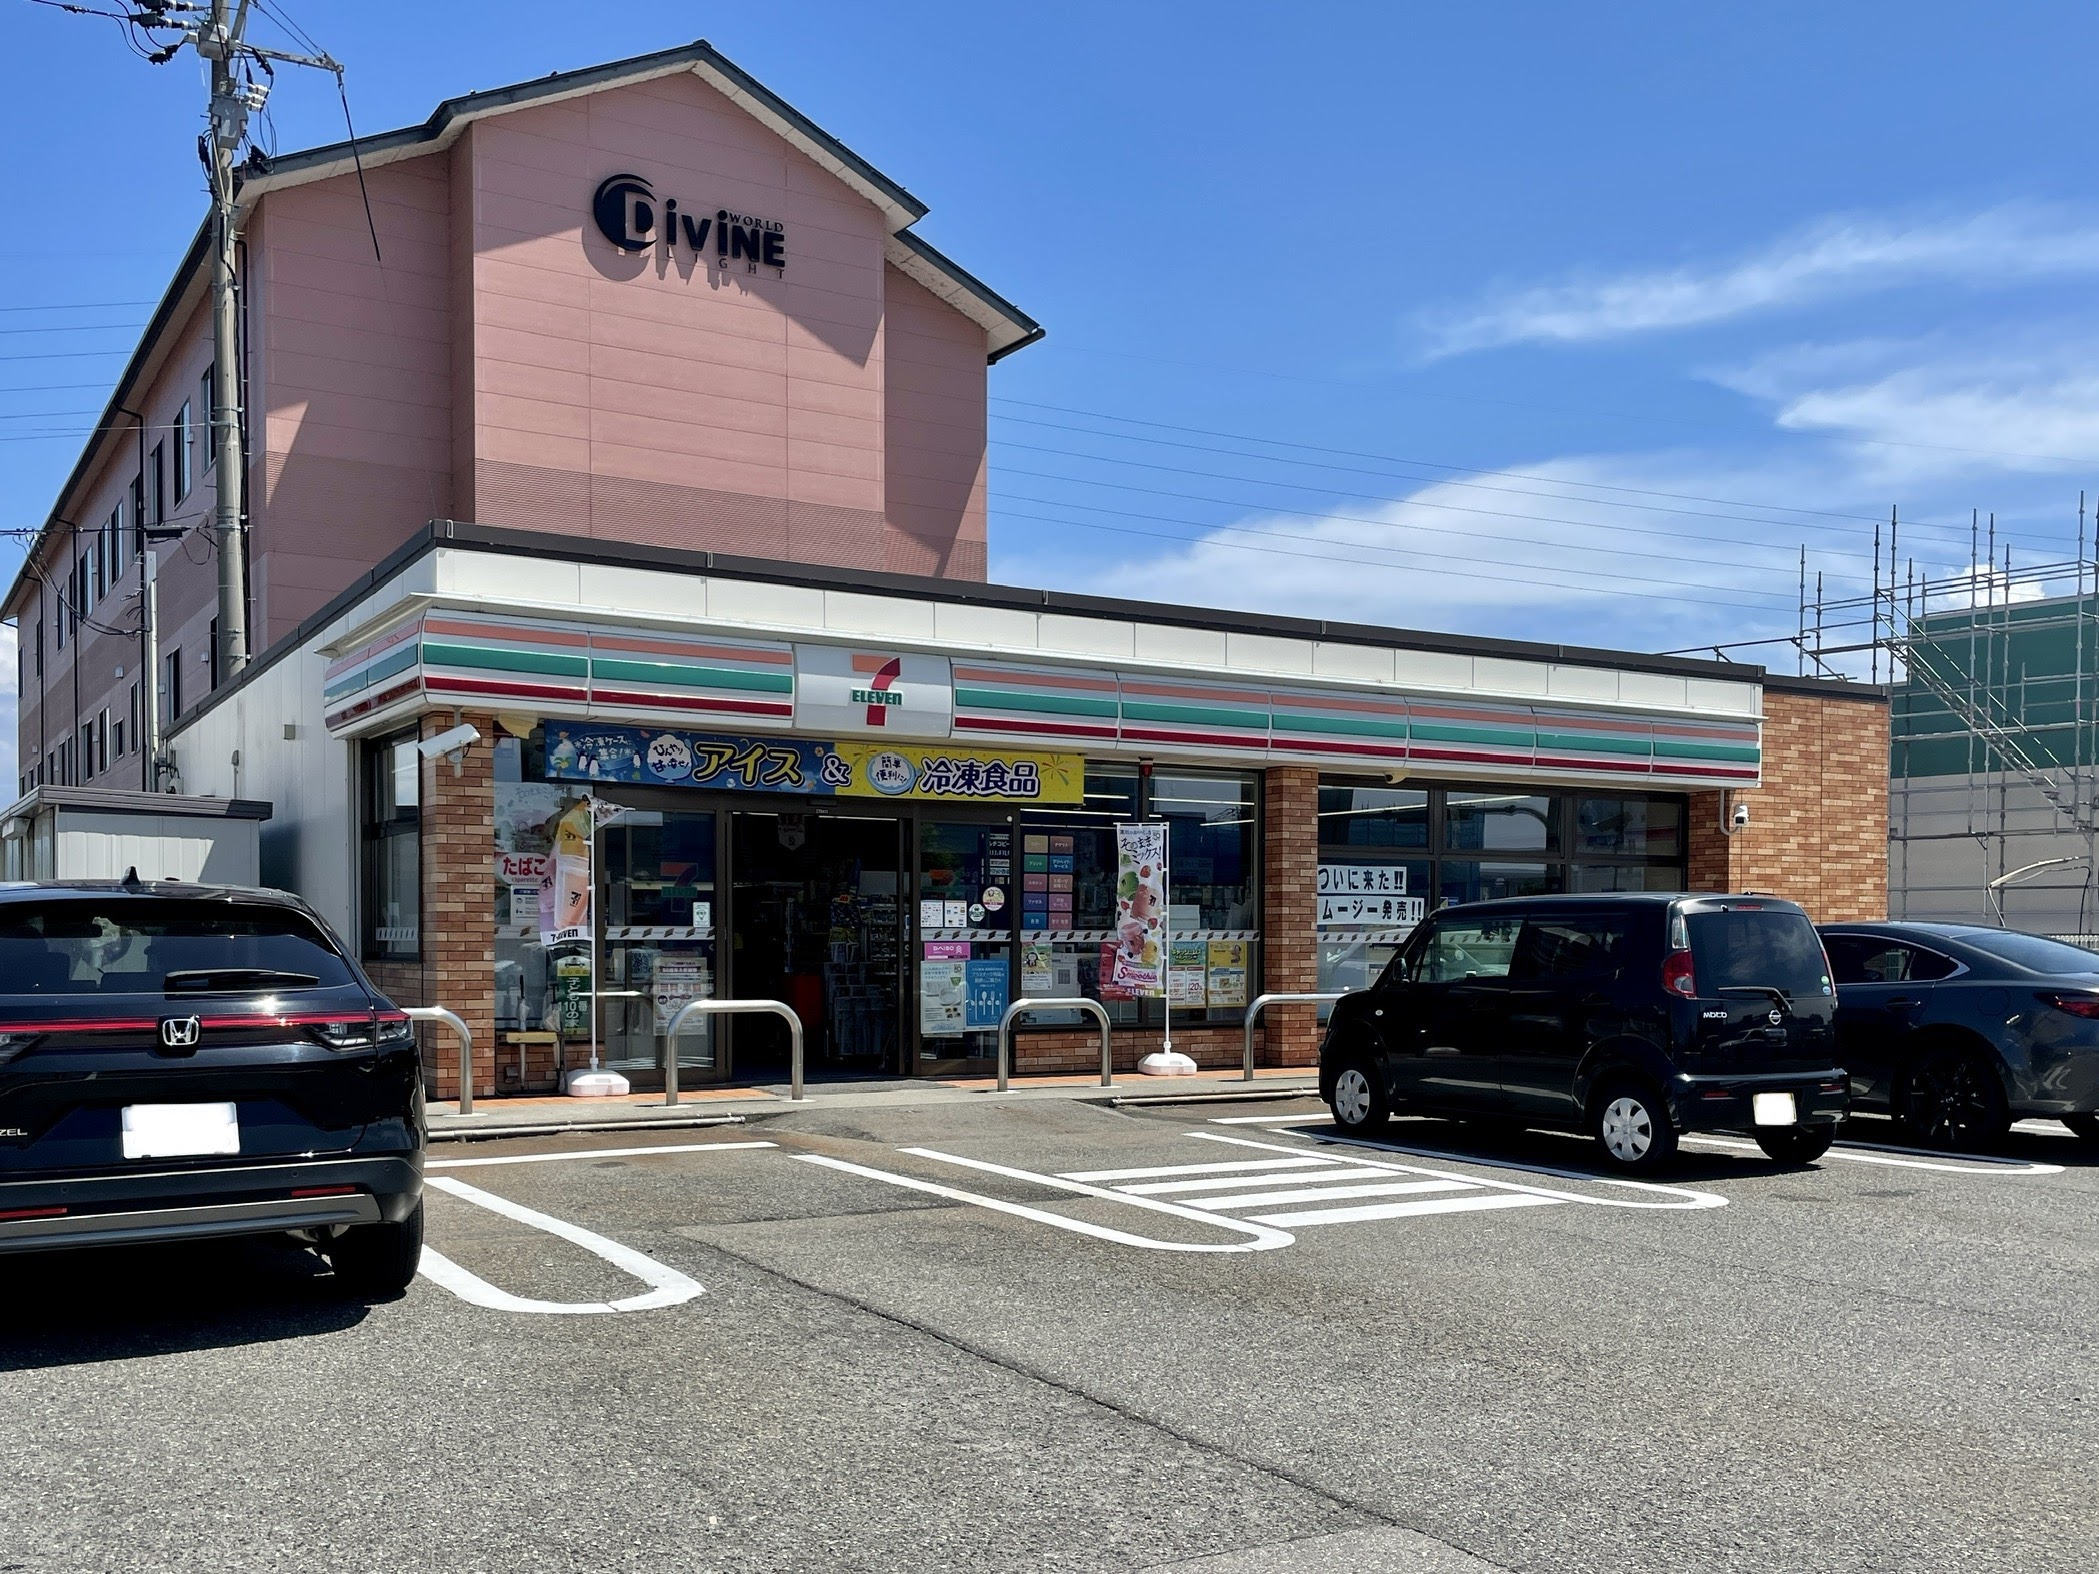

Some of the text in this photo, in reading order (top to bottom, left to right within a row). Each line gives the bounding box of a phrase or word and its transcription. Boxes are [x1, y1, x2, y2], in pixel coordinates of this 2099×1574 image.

[729, 212, 784, 232] WORLD
[667, 246, 785, 279] LIGHT
[652, 743, 683, 757] ひんやり
[692, 742, 1041, 797] アイス & 冷凍食品
[881, 756, 902, 769] 簡単
[503, 857, 546, 876] たばこ
[1318, 868, 1404, 890] ついに来た!!
[1322, 899, 1422, 921] ムージー発売!!
[0, 1128, 28, 1137] ZEL
